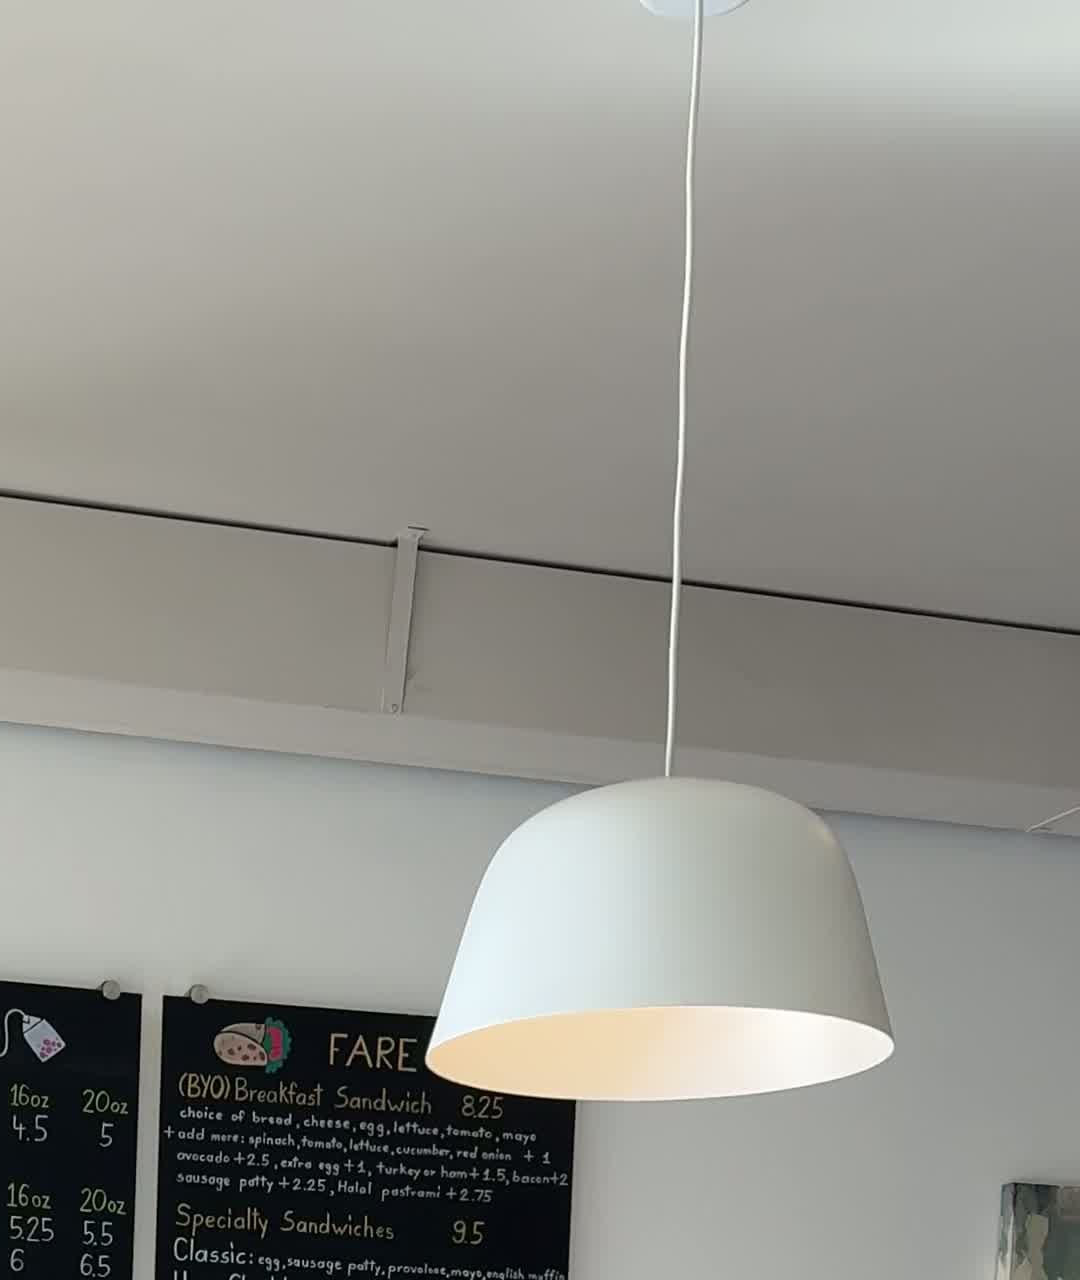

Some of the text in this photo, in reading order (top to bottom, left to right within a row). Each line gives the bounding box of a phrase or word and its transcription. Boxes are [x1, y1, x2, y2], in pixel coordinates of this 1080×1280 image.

[330, 1033, 417, 1072] FARE
[179, 1072, 503, 1119] (BYO) Breakfast Sandwich 8.25
[13, 1114, 48, 1142] 4.5
[99, 1122, 114, 1147] 5
[10, 1216, 54, 1242] 5.25
[83, 1220, 113, 1246] 5.5
[176, 1203, 485, 1244] Specialty Sandwiches 9.5
[10, 1248, 24, 1271] 6
[80, 1253, 111, 1277] 6.5
